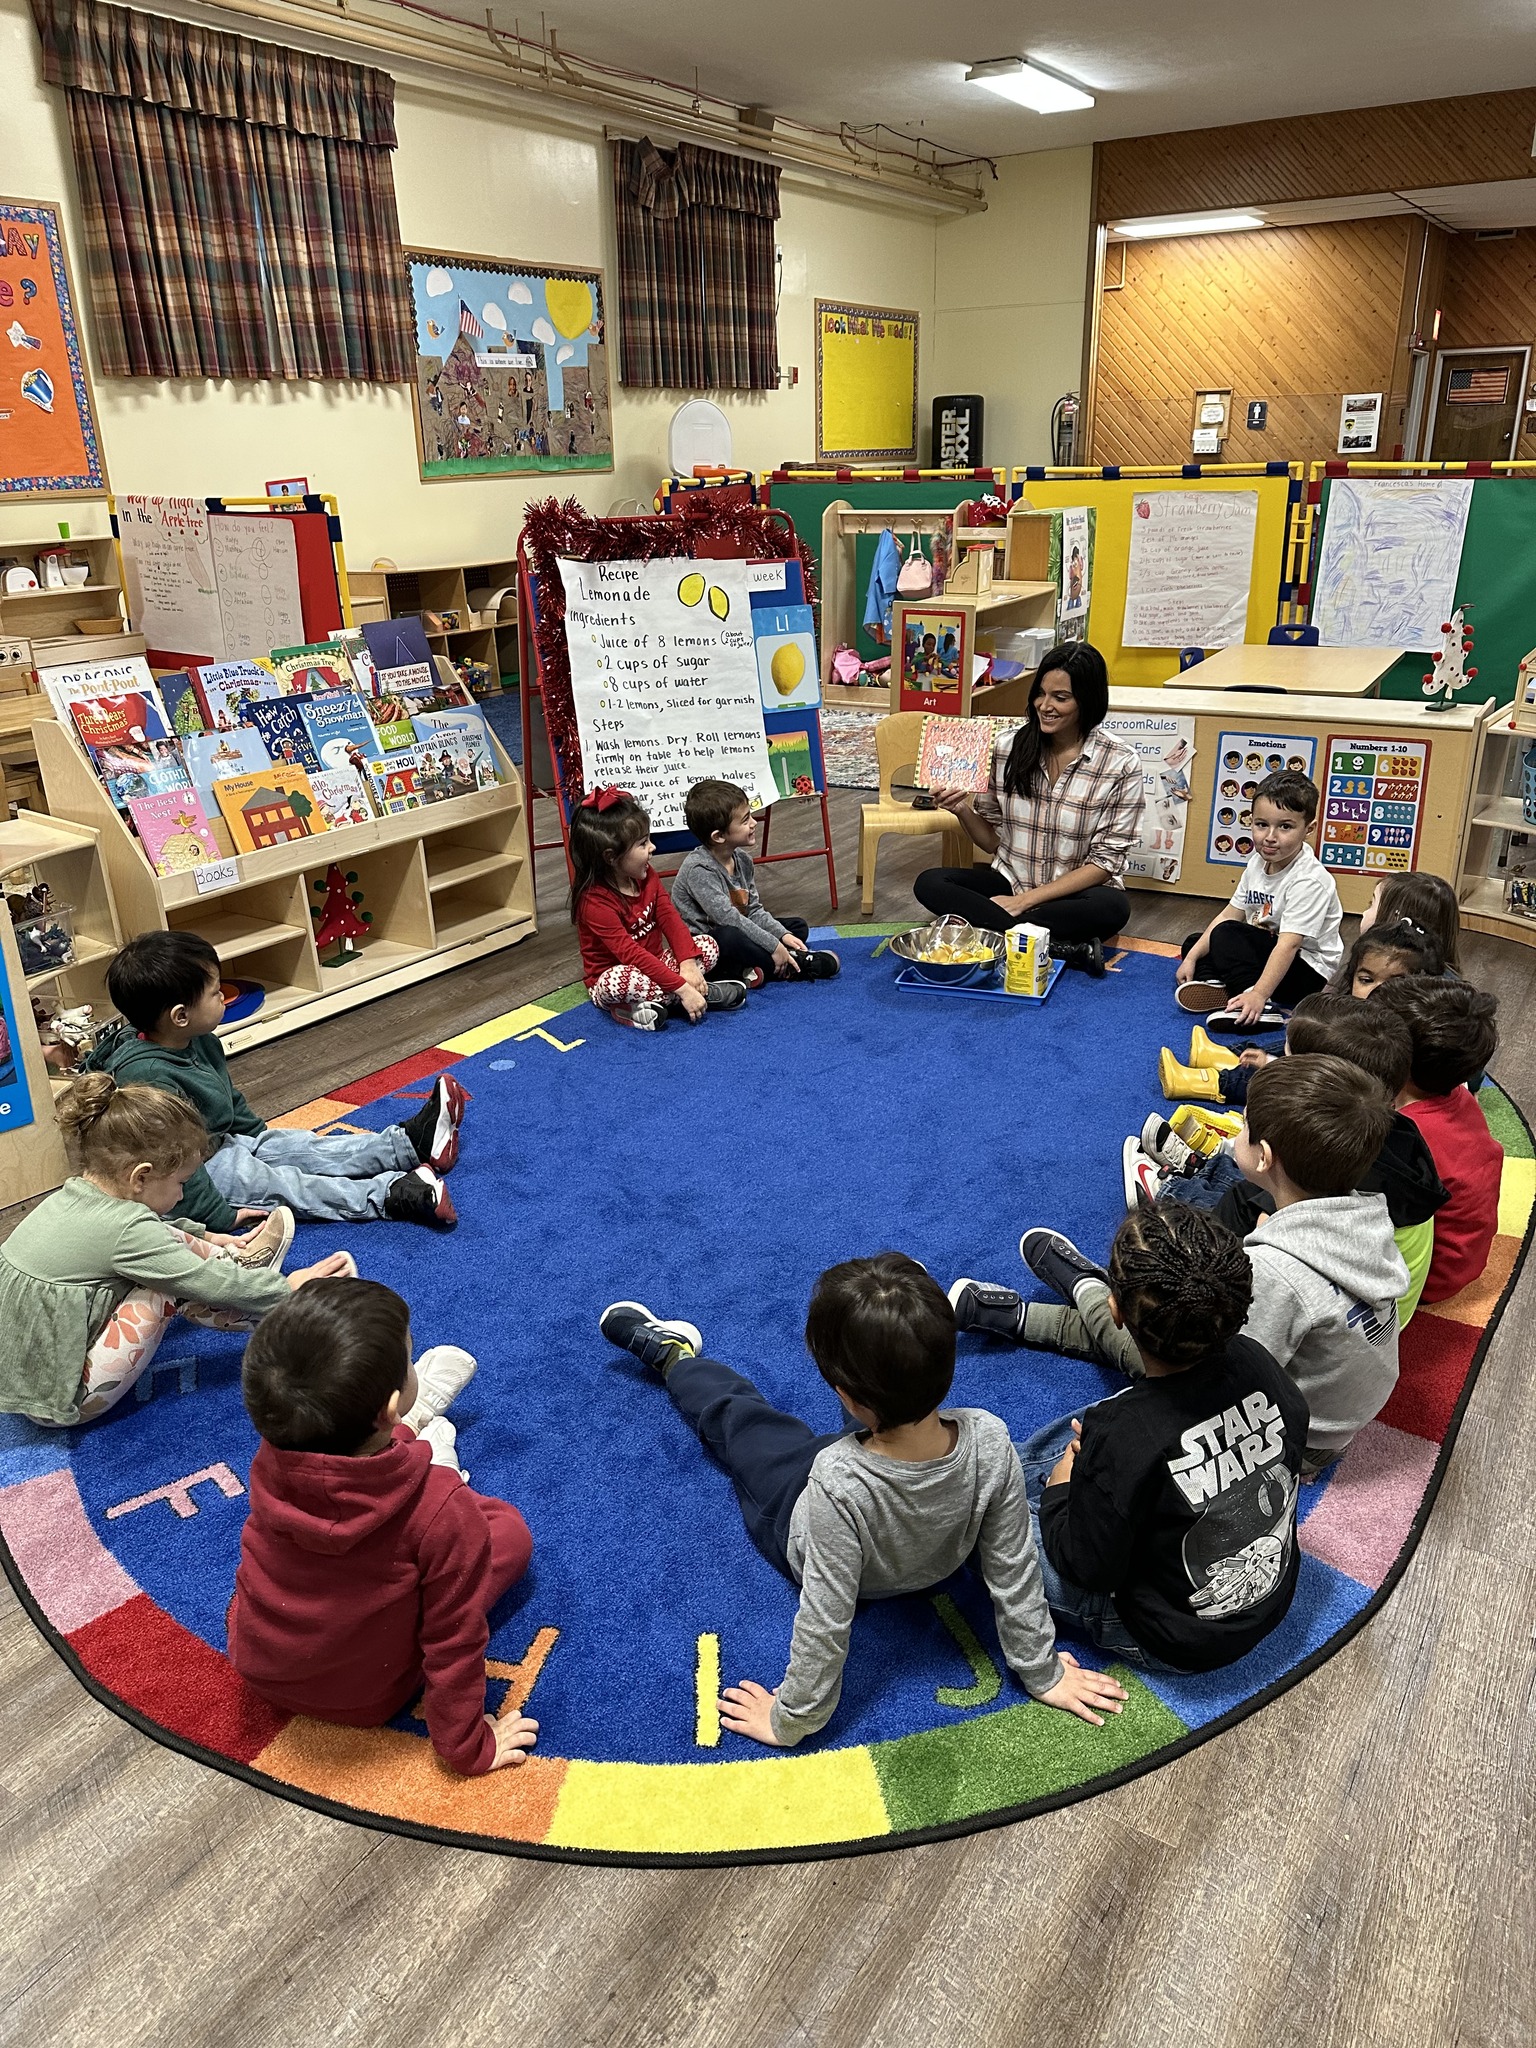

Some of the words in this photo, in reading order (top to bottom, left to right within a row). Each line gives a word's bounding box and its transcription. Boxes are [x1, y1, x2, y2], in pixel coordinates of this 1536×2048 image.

[1154, 494, 1223, 520] Strawberry
[1224, 495, 1250, 519] Jam
[122, 507, 132, 522] in
[137, 507, 152, 523] the
[161, 510, 185, 527] Apple
[186, 515, 203, 527] tree
[214, 517, 229, 532] How
[232, 520, 240, 532] do
[244, 525, 255, 535] you
[259, 521, 274, 533] feel?
[599, 565, 639, 582] Recipe
[579, 577, 650, 601] Lemonade
[634, 634, 649, 648] of
[658, 635, 666, 648] 8
[674, 635, 716, 647] lemons
[285, 659, 321, 672] Christmas
[320, 658, 335, 667] Tree
[605, 655, 613, 669] 2
[617, 659, 649, 673] cups
[653, 655, 668, 669] of
[204, 672, 224, 684] Little
[222, 668, 239, 679] Blue
[237, 665, 264, 677] Truck's
[387, 671, 396, 679] YOU
[80, 675, 140, 697] Pout-Pout
[219, 679, 259, 691] Christmas
[402, 678, 412, 686] THE
[609, 676, 619, 692] 8
[622, 679, 651, 692] cups
[655, 676, 668, 689] of
[674, 676, 708, 688] water
[608, 698, 624, 709] 1-2
[626, 698, 664, 713] lemons,
[698, 697, 712, 707] for
[715, 694, 755, 710] garnish
[923, 697, 937, 706] Art
[304, 699, 352, 719] Sneezy
[254, 705, 279, 728] How
[271, 705, 298, 734] Catch
[316, 710, 366, 728] Snowman
[81, 718, 128, 734] Christmas
[376, 725, 398, 736] FOOD
[431, 719, 449, 730] The
[593, 718, 625, 732] Steps
[388, 732, 416, 746] WORLD
[595, 740, 621, 751] Wash
[696, 732, 720, 743] Roll
[724, 731, 761, 741] lemons
[1248, 739, 1286, 749] Emotions
[414, 743, 438, 754] CAPTAIN
[595, 751, 625, 765] firmly
[629, 754, 642, 762] on
[647, 750, 672, 762] table
[678, 748, 691, 758] to
[694, 747, 715, 758] help
[721, 744, 755, 755] lemons
[1135, 742, 1161, 754] Ears
[1350, 743, 1388, 752] Numbers
[1391, 745, 1408, 753] 1-10
[1334, 756, 1343, 770] 1
[1379, 759, 1389, 773] 6
[594, 765, 632, 777] release
[635, 765, 659, 775] their
[669, 777, 679, 786] of
[722, 771, 756, 781] halves
[223, 783, 235, 792] My
[235, 780, 254, 789] House
[322, 783, 358, 800] Christmas
[1331, 780, 1342, 793] 2
[1377, 782, 1388, 796] 7
[137, 799, 155, 811] The
[157, 796, 178, 807] Best
[1329, 802, 1339, 815] 3
[150, 808, 172, 820] Nest
[1373, 806, 1384, 819] 8
[652, 818, 675, 828] and
[1327, 825, 1336, 838] 4
[1371, 828, 1381, 842] 9
[1325, 848, 1335, 861] 5
[1367, 851, 1386, 866] 10
[195, 863, 234, 885] Books
[1167, 1391, 1281, 1475] STAR
[1172, 1416, 1287, 1508] WARS
